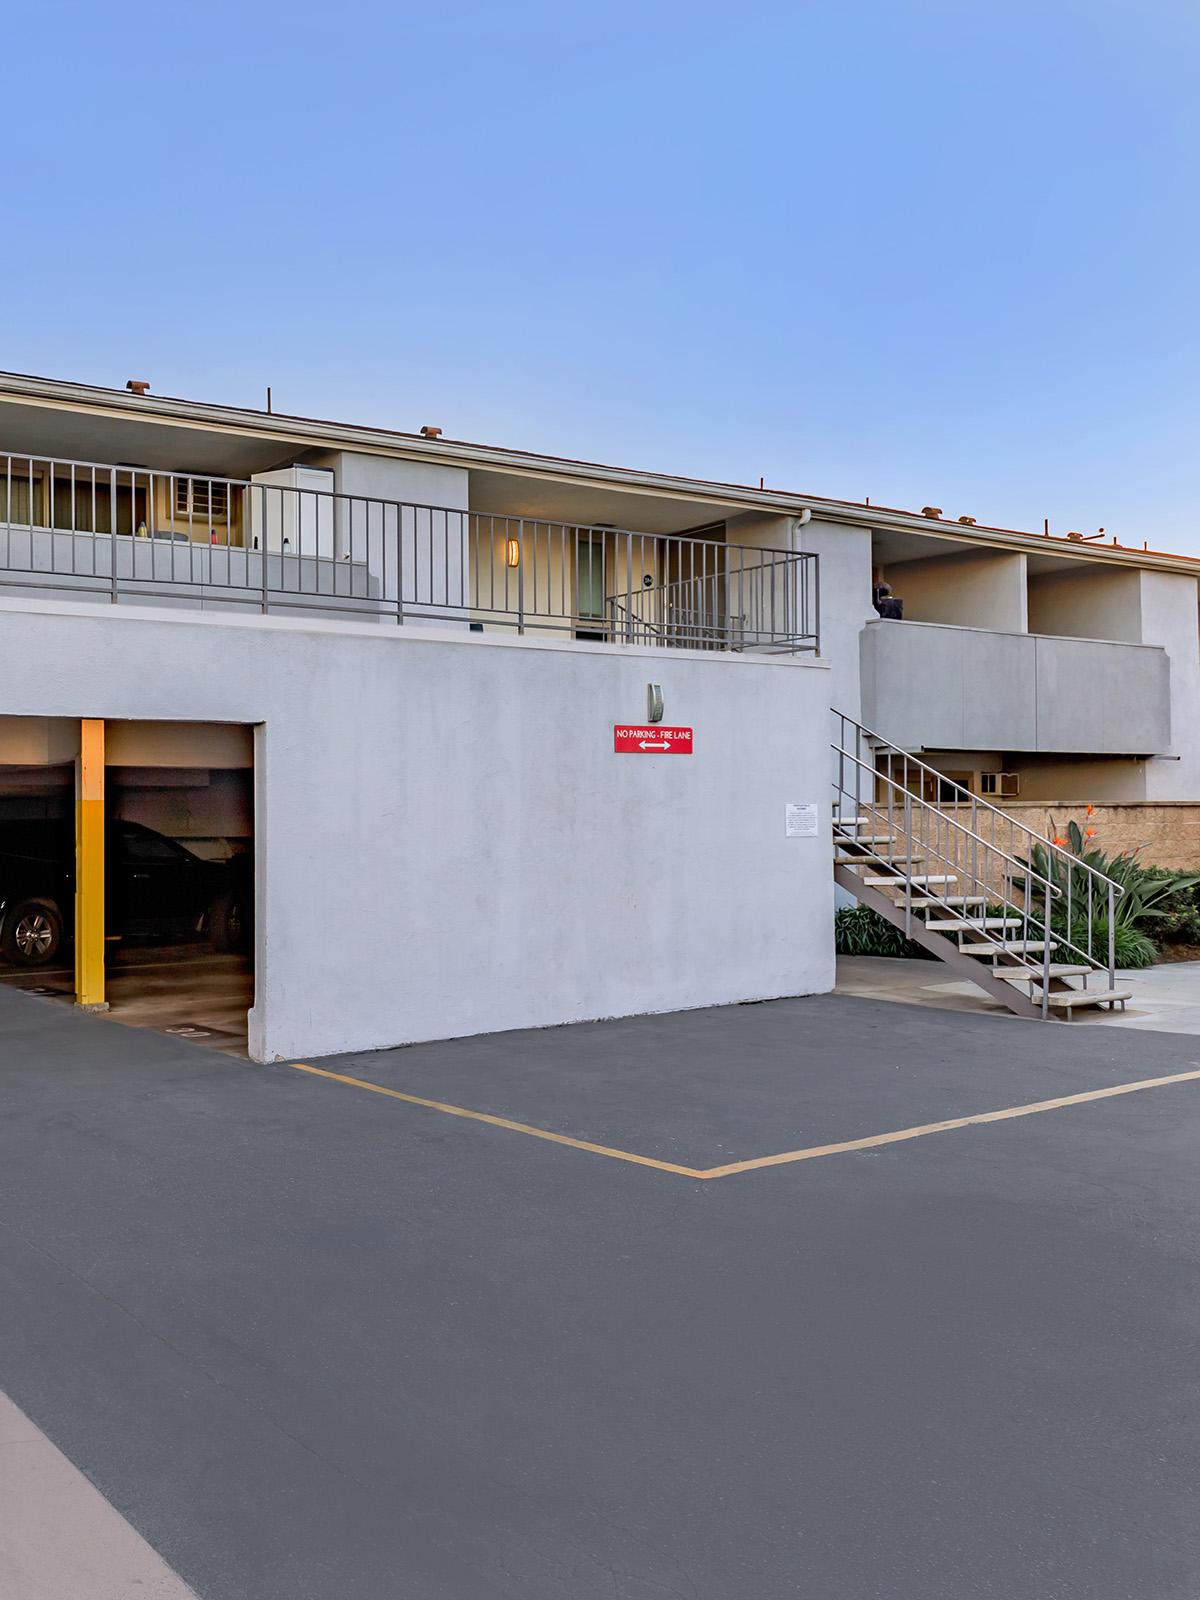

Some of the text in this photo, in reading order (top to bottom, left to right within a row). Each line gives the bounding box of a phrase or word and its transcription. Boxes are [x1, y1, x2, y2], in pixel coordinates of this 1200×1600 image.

[616, 730, 628, 738] NO
[629, 730, 656, 739] PARKING
[660, 731, 673, 739] FIRE
[673, 731, 692, 740] LANE
